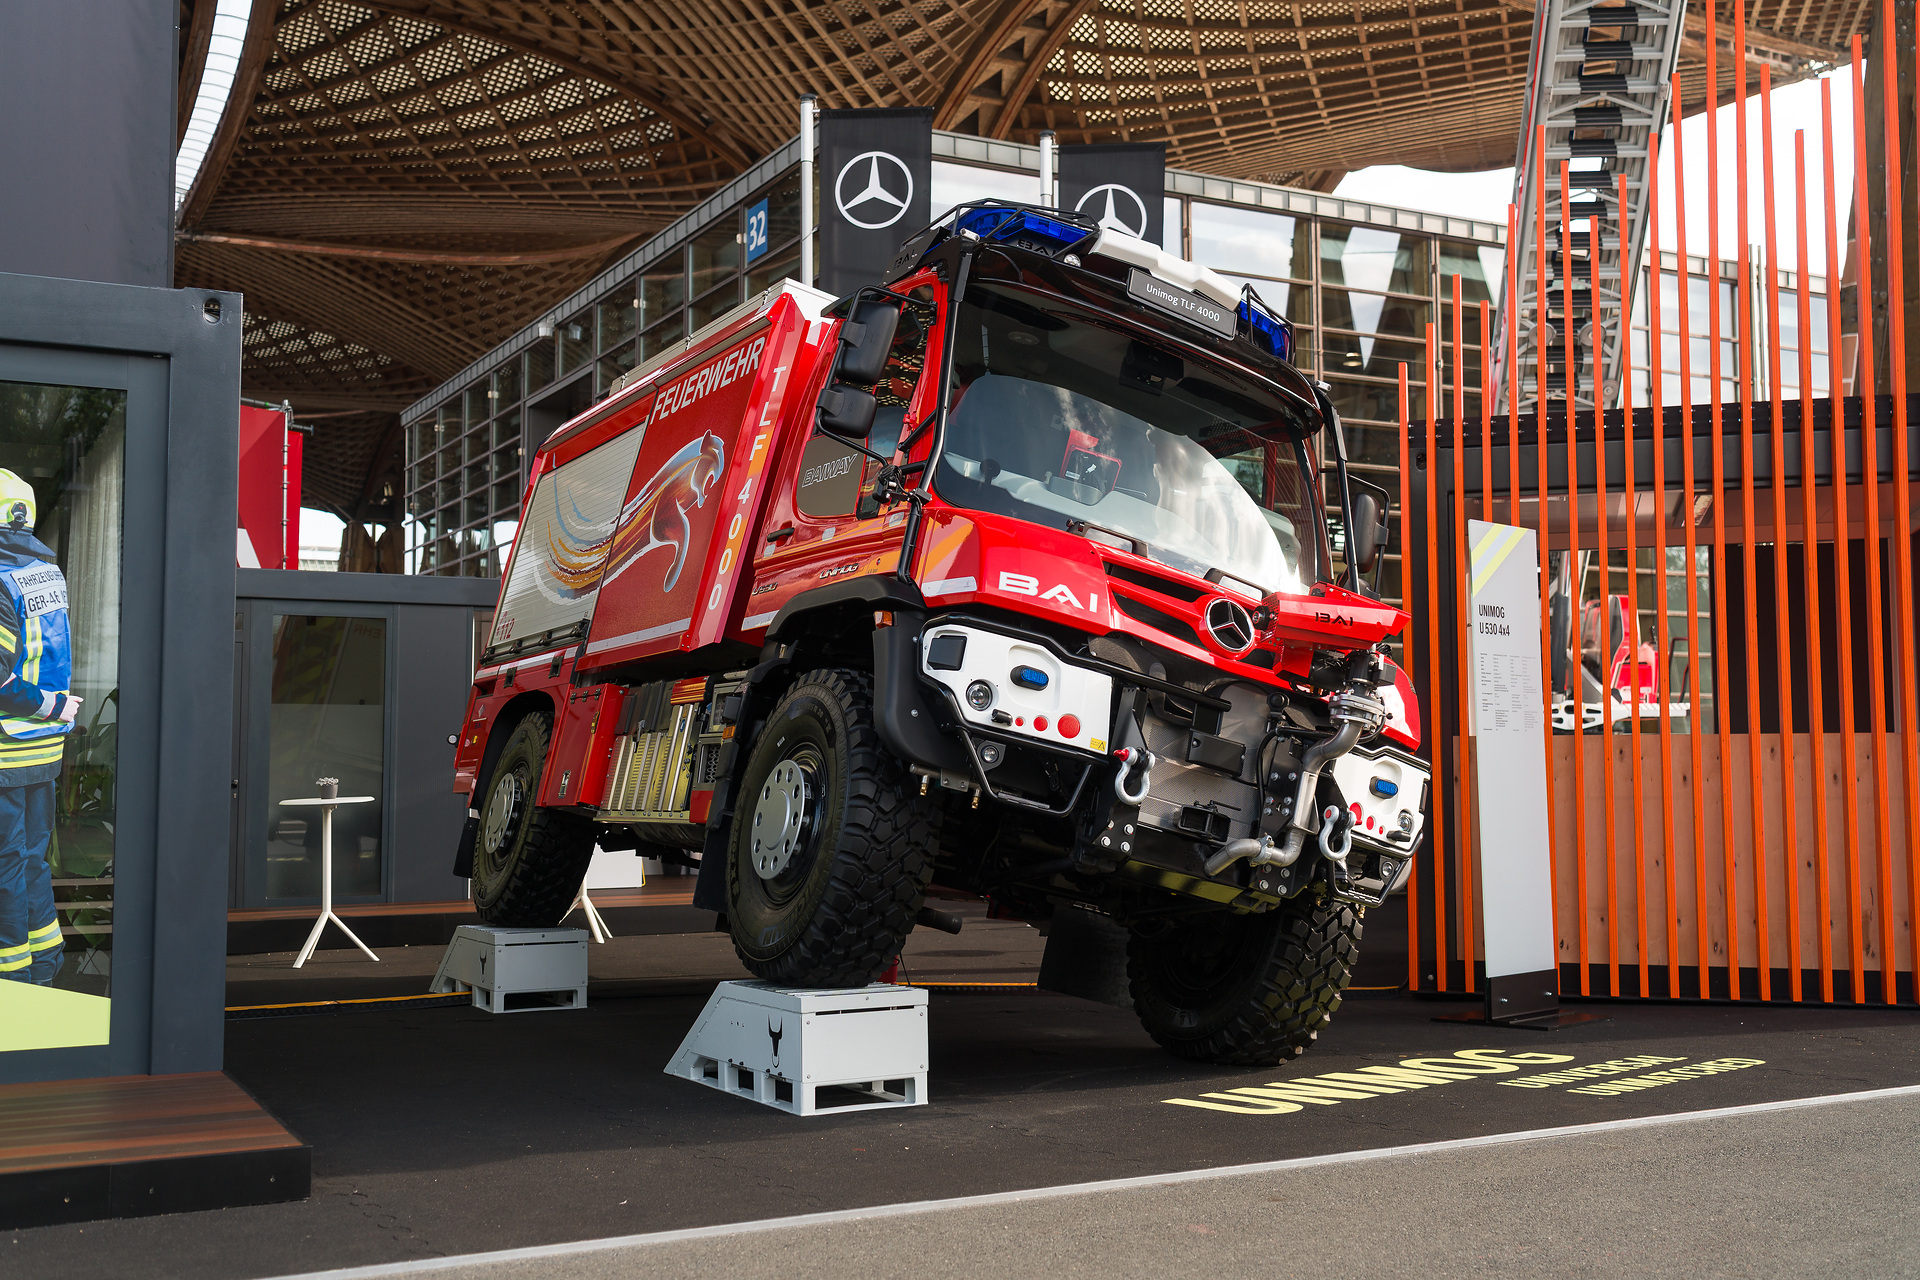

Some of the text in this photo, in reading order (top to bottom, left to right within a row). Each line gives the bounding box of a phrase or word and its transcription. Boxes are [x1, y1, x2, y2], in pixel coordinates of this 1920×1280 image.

[750, 210, 766, 251] 32
[1146, 283, 1220, 322] Unimog TLF 4000
[650, 336, 766, 425] FEUERWEHR
[708, 365, 787, 611] TLF 4000
[802, 453, 859, 488] BAIWAY
[998, 571, 1098, 613] BAI
[1478, 604, 1505, 619] UNIMOG
[1315, 612, 1353, 626] BAI
[1485, 622, 1498, 635] 530
[1498, 624, 1511, 636] 4x4
[1160, 1049, 1575, 1115] UNIMOG
[1496, 1055, 1688, 1089] UNIVERSAL
[1566, 1057, 1766, 1096] UNMATCHED
